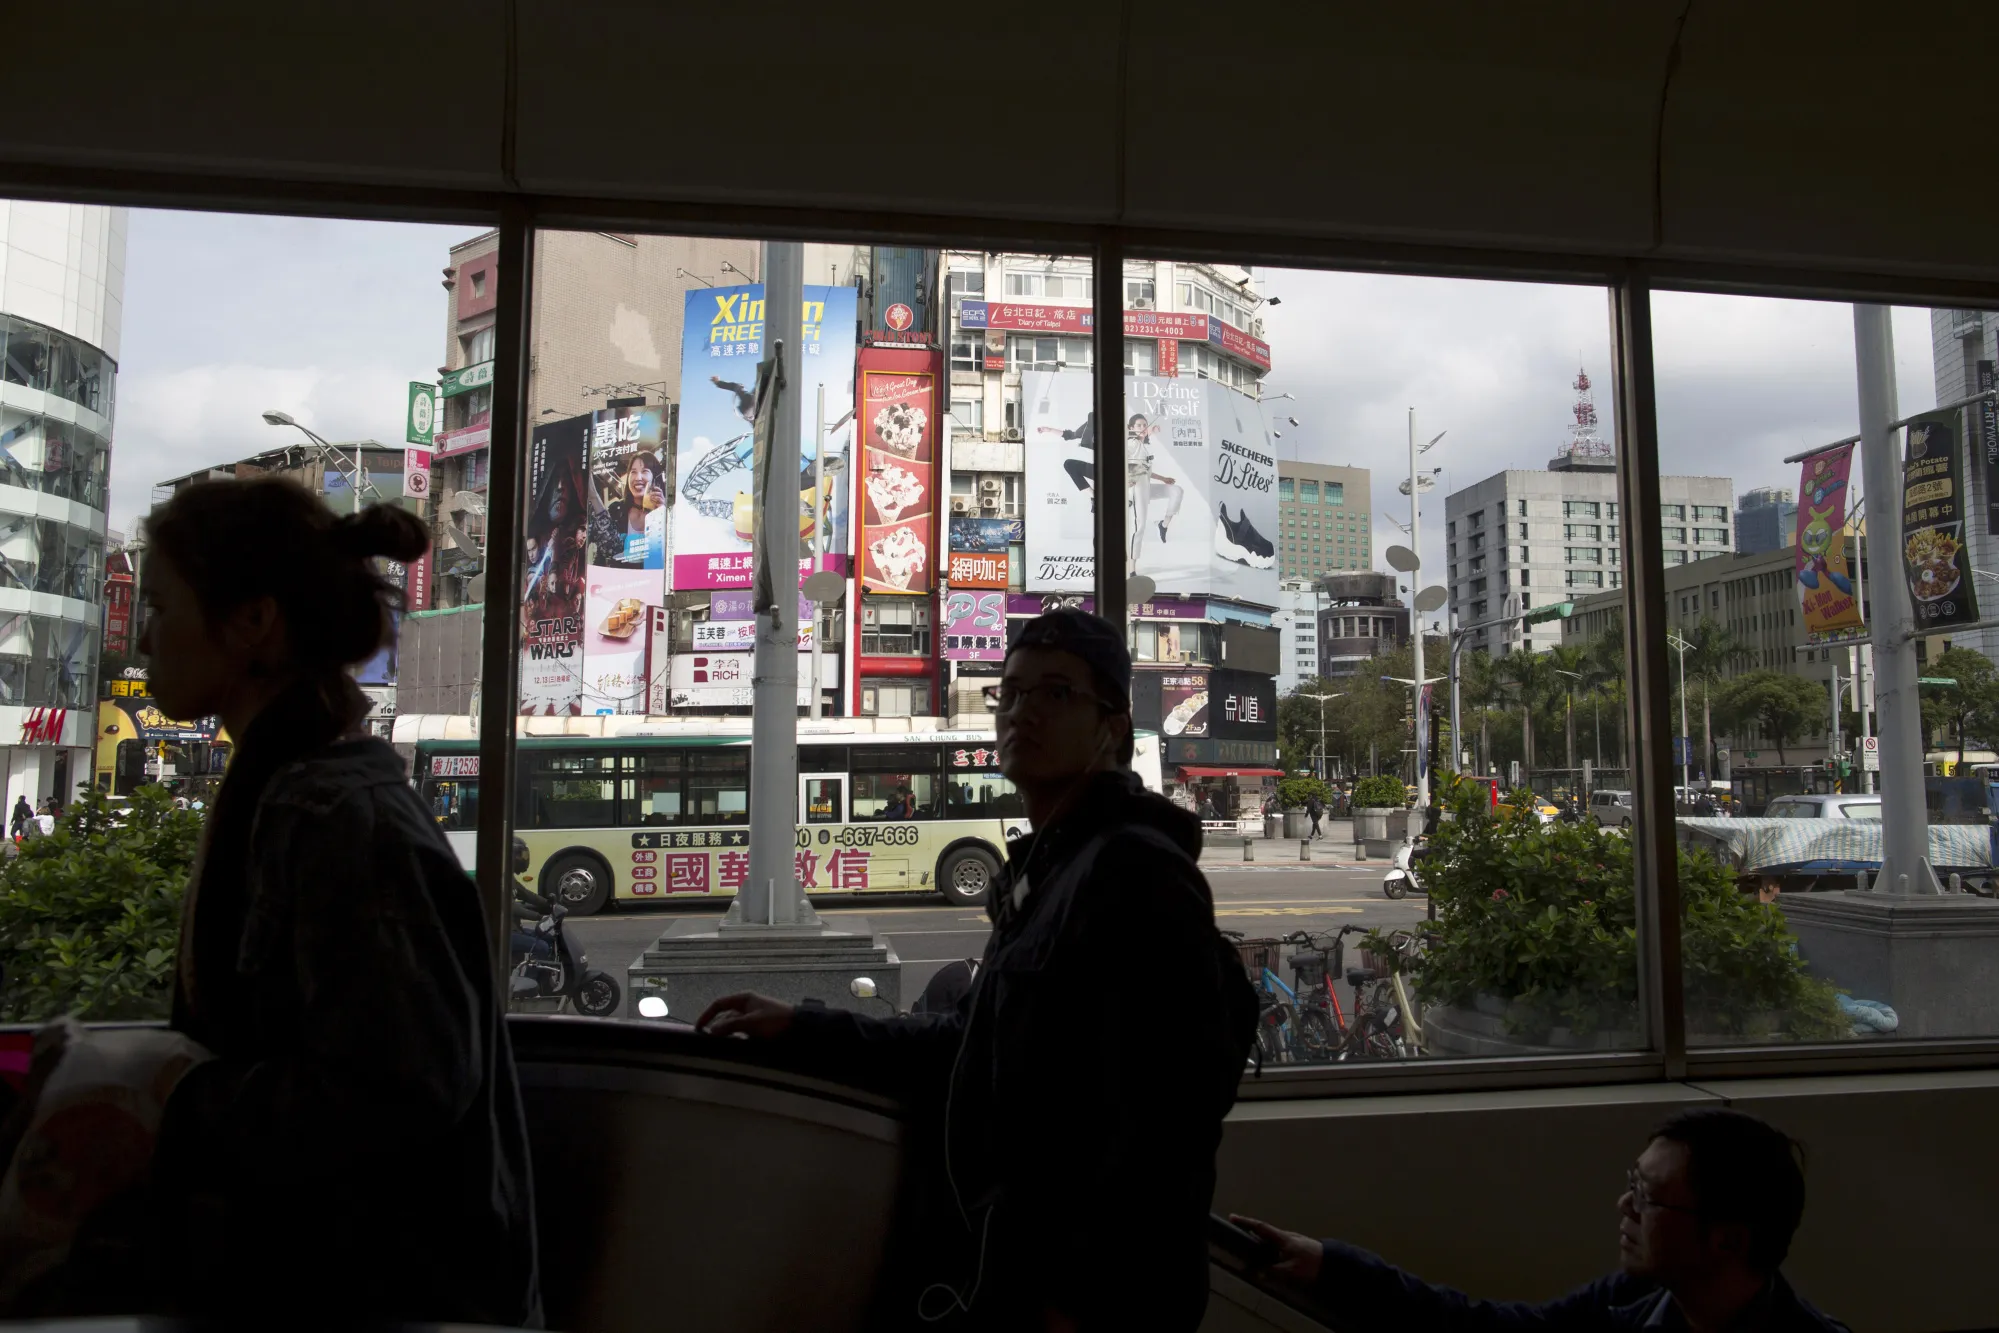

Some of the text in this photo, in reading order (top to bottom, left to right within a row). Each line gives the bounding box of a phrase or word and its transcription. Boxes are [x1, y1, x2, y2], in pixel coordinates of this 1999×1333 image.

[1018, 319, 1034, 327] Diary
[1044, 320, 1061, 328] Taipei
[710, 324, 764, 344] FREE
[1144, 382, 1201, 399] Define
[1144, 399, 1201, 420] Myself
[594, 415, 641, 447] 惠吃
[1220, 440, 1274, 467] SKECHERS
[951, 557, 996, 583] 網咖
[531, 617, 577, 638] STAR
[696, 627, 725, 640] 玉芙蓉
[530, 641, 577, 660] WARS
[712, 671, 739, 681] RICH
[111, 680, 153, 697] 西門
[20, 706, 66, 743] H&M
[930, 734, 956, 742] CHUNG
[459, 757, 479, 775] 2528
[660, 832, 722, 847] 日夜服務
[635, 868, 654, 877] 工商
